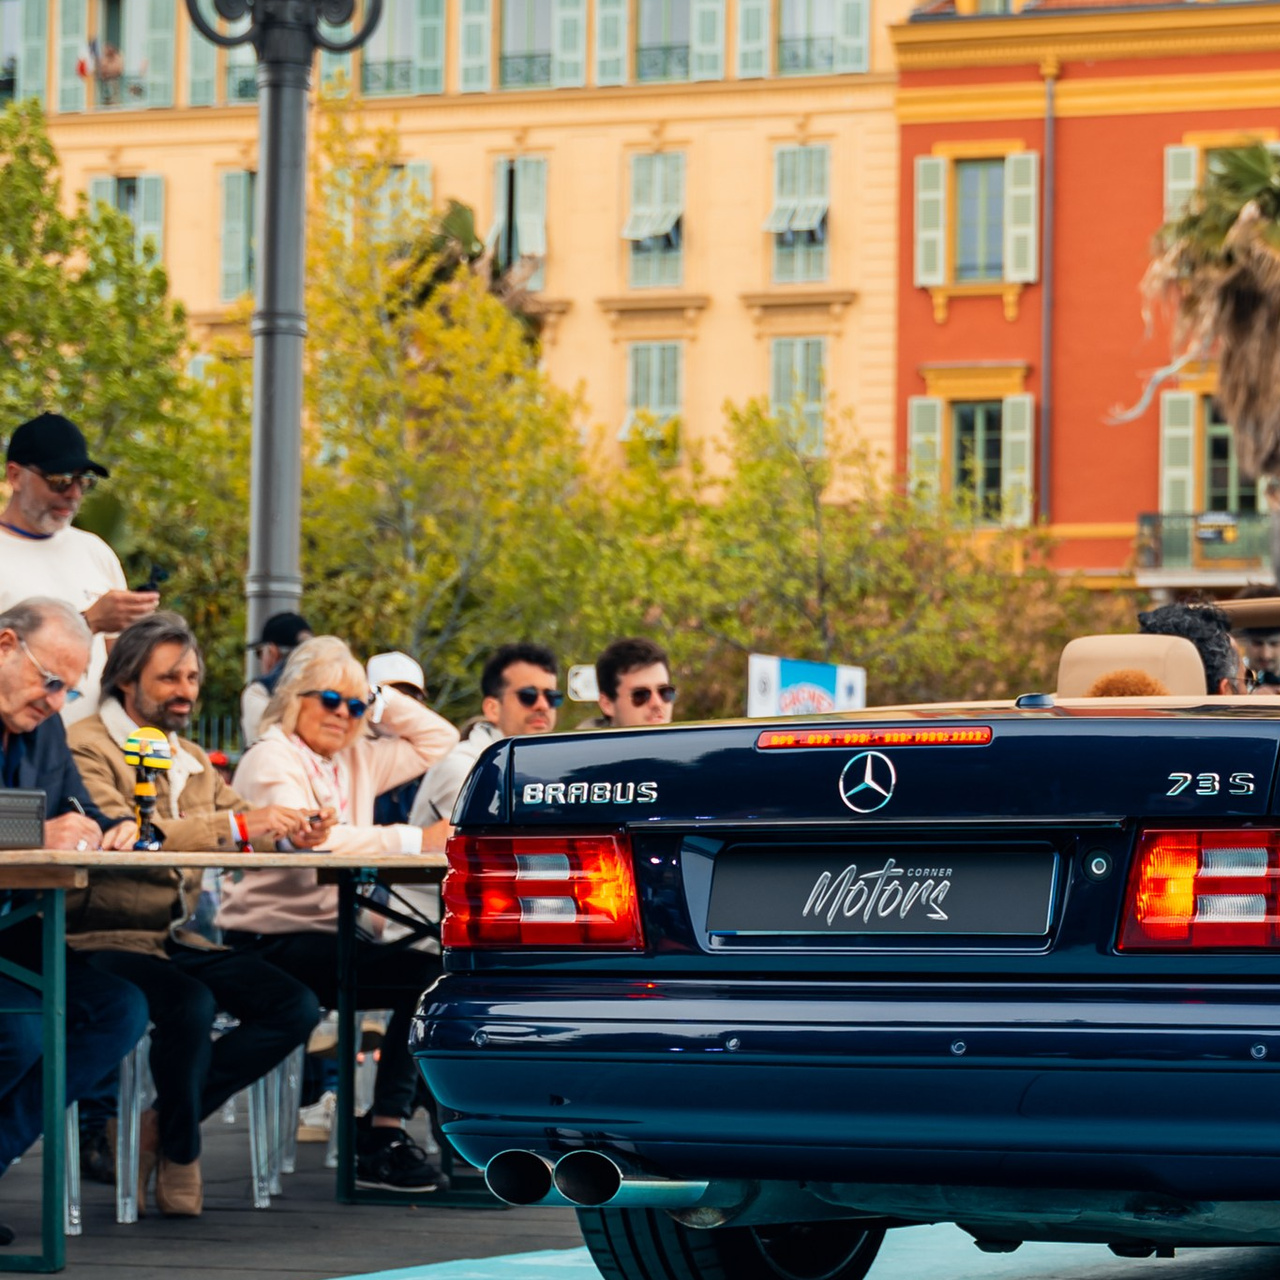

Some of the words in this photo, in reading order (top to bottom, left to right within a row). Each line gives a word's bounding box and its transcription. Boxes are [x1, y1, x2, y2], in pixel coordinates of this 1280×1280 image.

[522, 781, 658, 804] BRABUS
[1166, 772, 1220, 796] 73
[1228, 772, 1255, 795] S
[907, 868, 953, 877] CORNER
[802, 858, 951, 926] Motors
